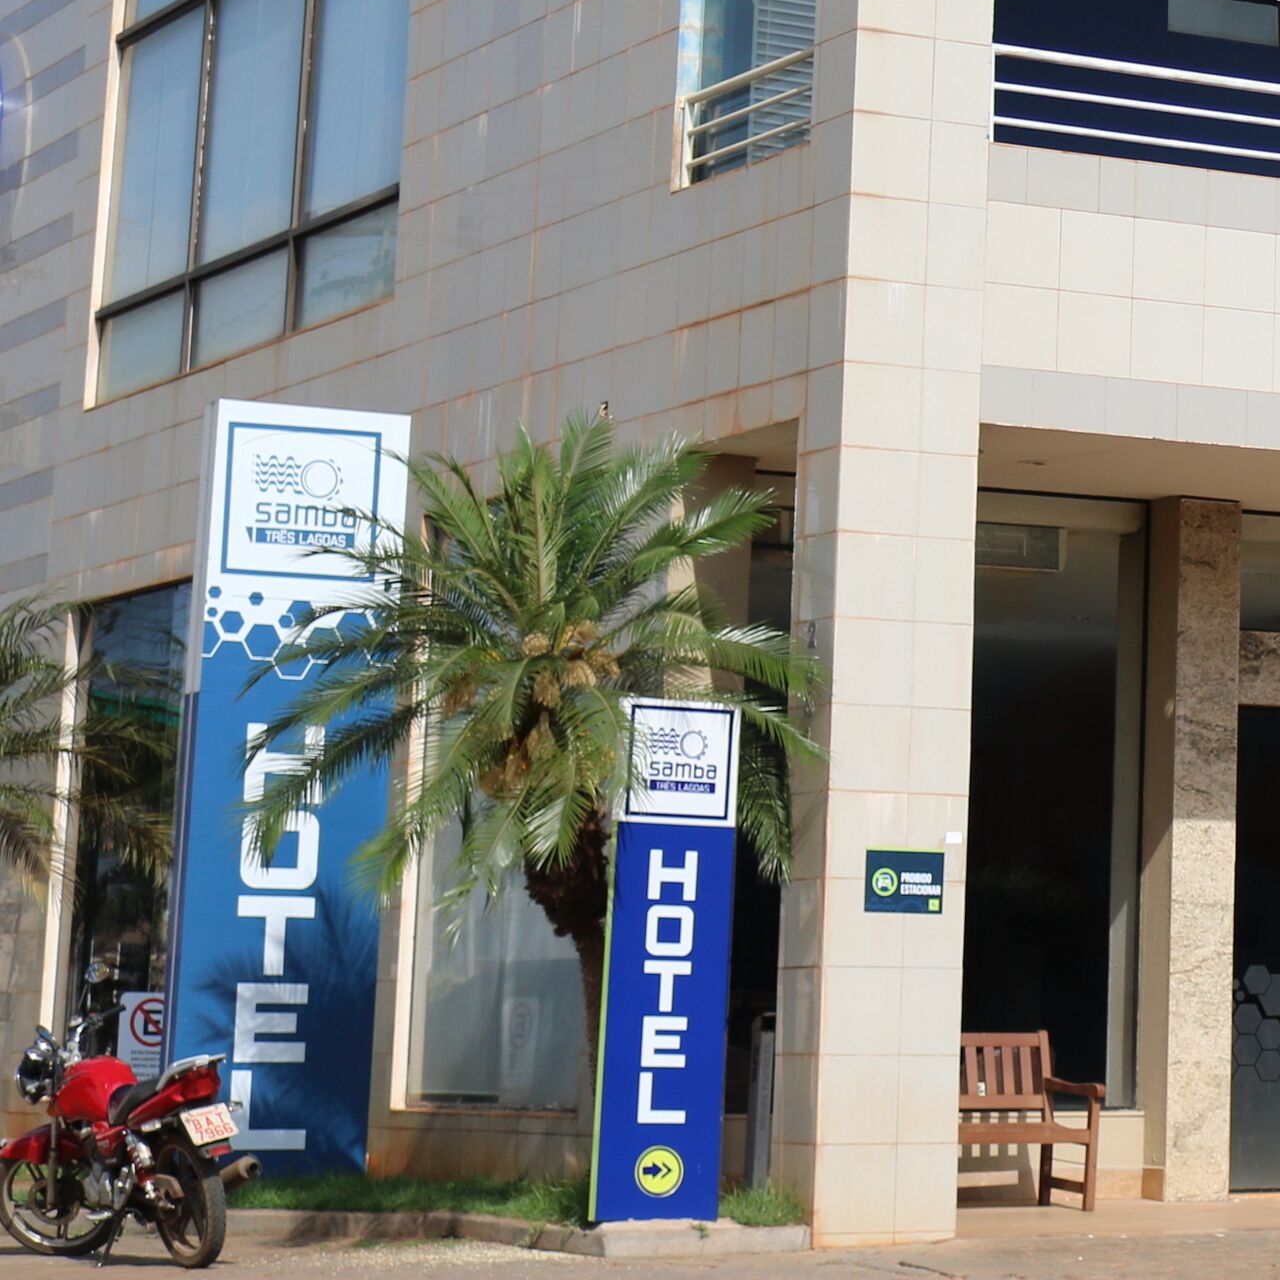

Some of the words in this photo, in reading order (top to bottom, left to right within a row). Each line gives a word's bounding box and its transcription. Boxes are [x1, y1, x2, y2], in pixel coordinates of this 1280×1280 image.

[255, 501, 357, 529] samba
[265, 528, 295, 545] TRÊS
[299, 532, 346, 548] LAGOAS
[648, 760, 717, 780] samba
[230, 722, 326, 1150] HOTEL
[637, 849, 699, 1125] HOTEL
